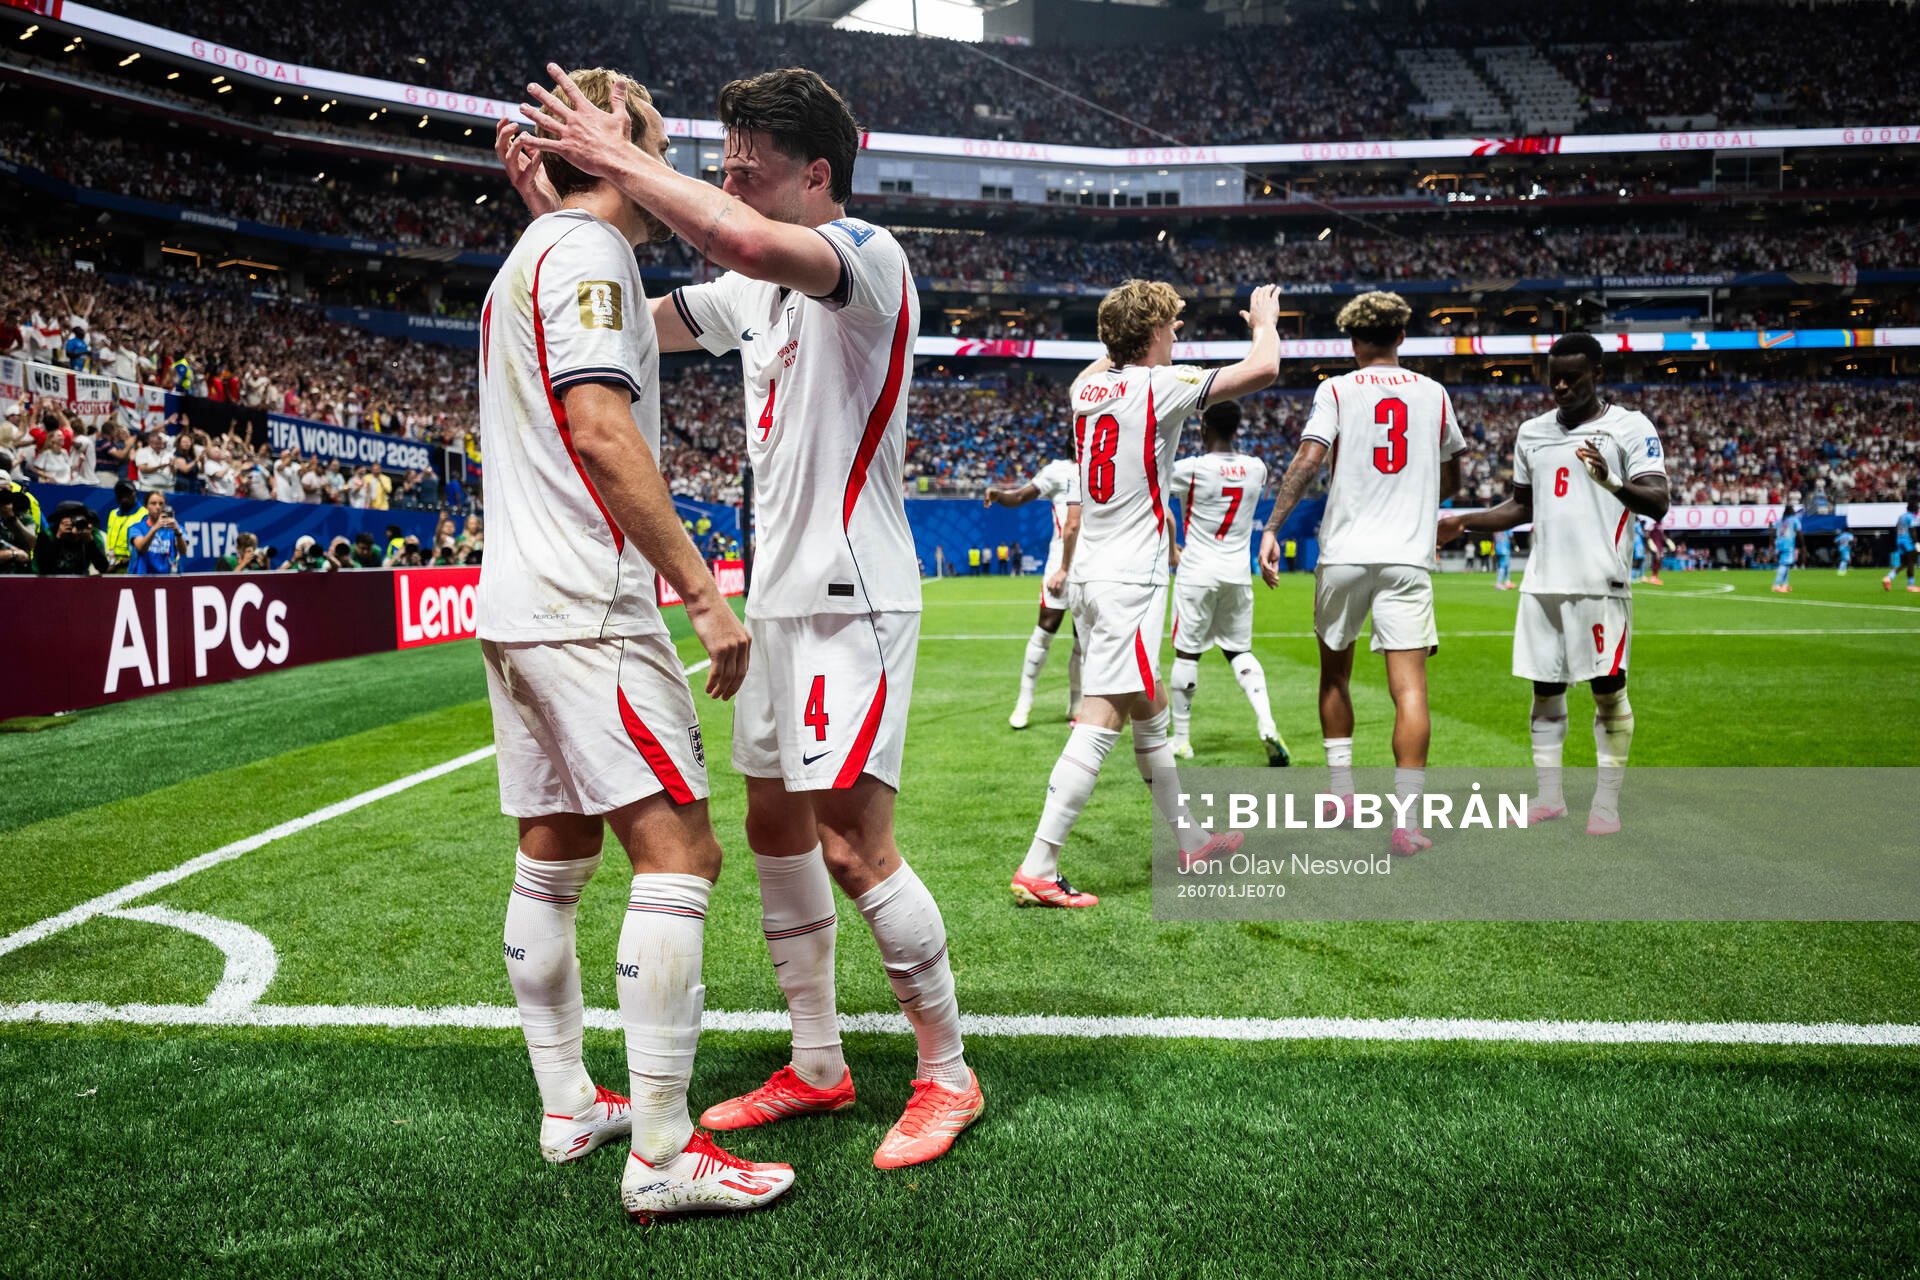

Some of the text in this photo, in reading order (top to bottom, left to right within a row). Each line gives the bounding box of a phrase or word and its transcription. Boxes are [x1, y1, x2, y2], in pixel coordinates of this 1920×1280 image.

[192, 39, 306, 85] GOOOAL
[405, 84, 512, 118] GOOOAL
[1659, 131, 1758, 150] GOOOAL
[1843, 127, 1920, 145] GOOO
[963, 140, 1050, 161] GOOOAL
[1128, 146, 1222, 165] GOOOAL
[1302, 142, 1399, 161] GOOOAL
[1281, 284, 1333, 294] LANTA
[408, 316, 433, 328] FIFA
[435, 318, 475, 331] WORLD
[1280, 341, 1345, 357] GOOO
[1617, 334, 1632, 351] 1
[1691, 332, 1711, 350] 1
[35, 370, 60, 393] NG5
[1080, 381, 1128, 403] GORON
[757, 379, 776, 442] 4
[267, 419, 430, 470] FIFA WORLD CUP 2026
[1373, 397, 1408, 475] 3
[1075, 413, 1119, 504] 18
[1554, 466, 1570, 498] 6
[1215, 487, 1244, 540] 7
[1661, 506, 1778, 529] GOOOA
[184, 521, 239, 558] FIFA
[400, 574, 480, 642] Leno
[103, 582, 290, 694] AI PCs
[1592, 622, 1605, 655] 6
[803, 674, 829, 742] 4
[503, 942, 526, 961] ENG
[615, 961, 640, 979] ENG
